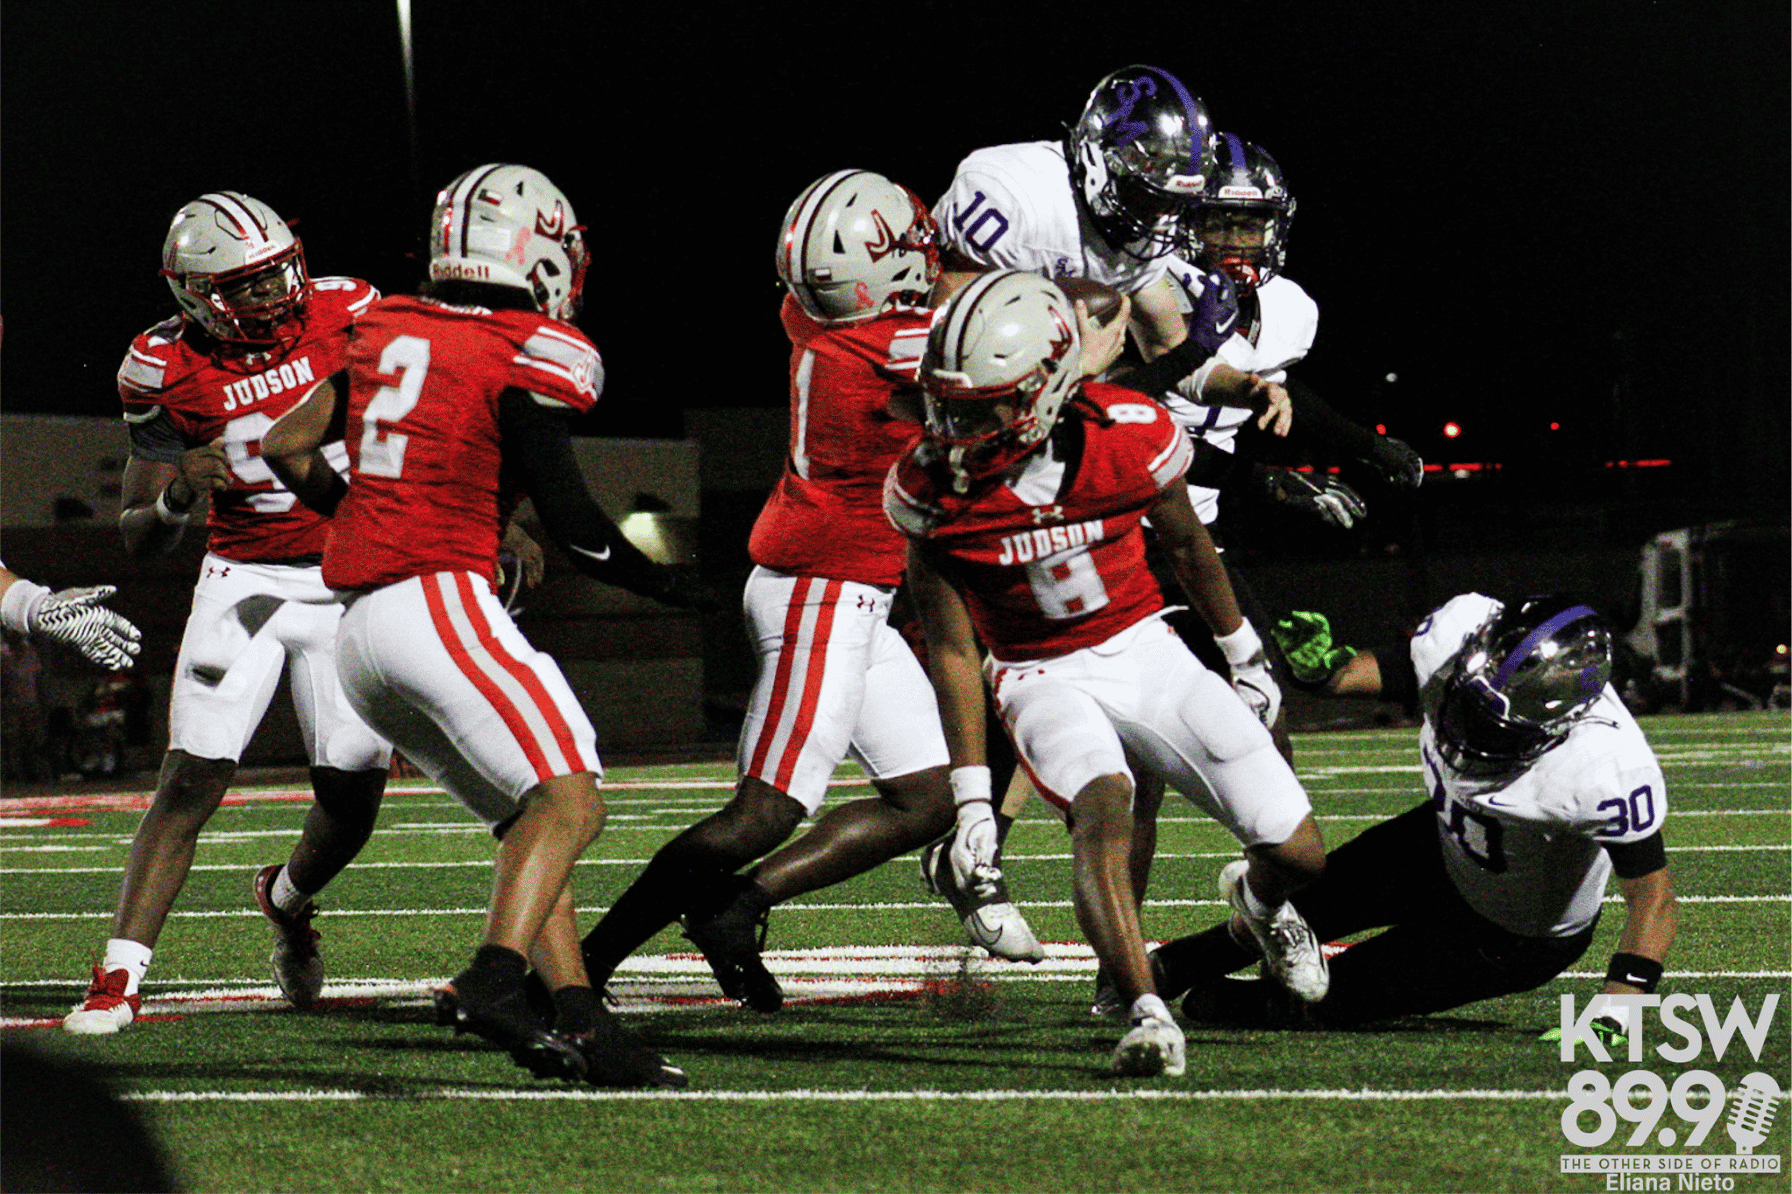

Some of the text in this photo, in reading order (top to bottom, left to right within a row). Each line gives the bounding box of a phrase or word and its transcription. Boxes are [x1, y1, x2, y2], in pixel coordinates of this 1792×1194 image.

[951, 190, 1010, 253] 10
[432, 263, 491, 280] Riddell
[222, 356, 315, 411] JUDSON
[358, 334, 431, 478] 2
[1107, 402, 1158, 424] 8
[998, 520, 1105, 567] JUDSON
[1028, 546, 1111, 620] 8
[1595, 784, 1655, 837] 30
